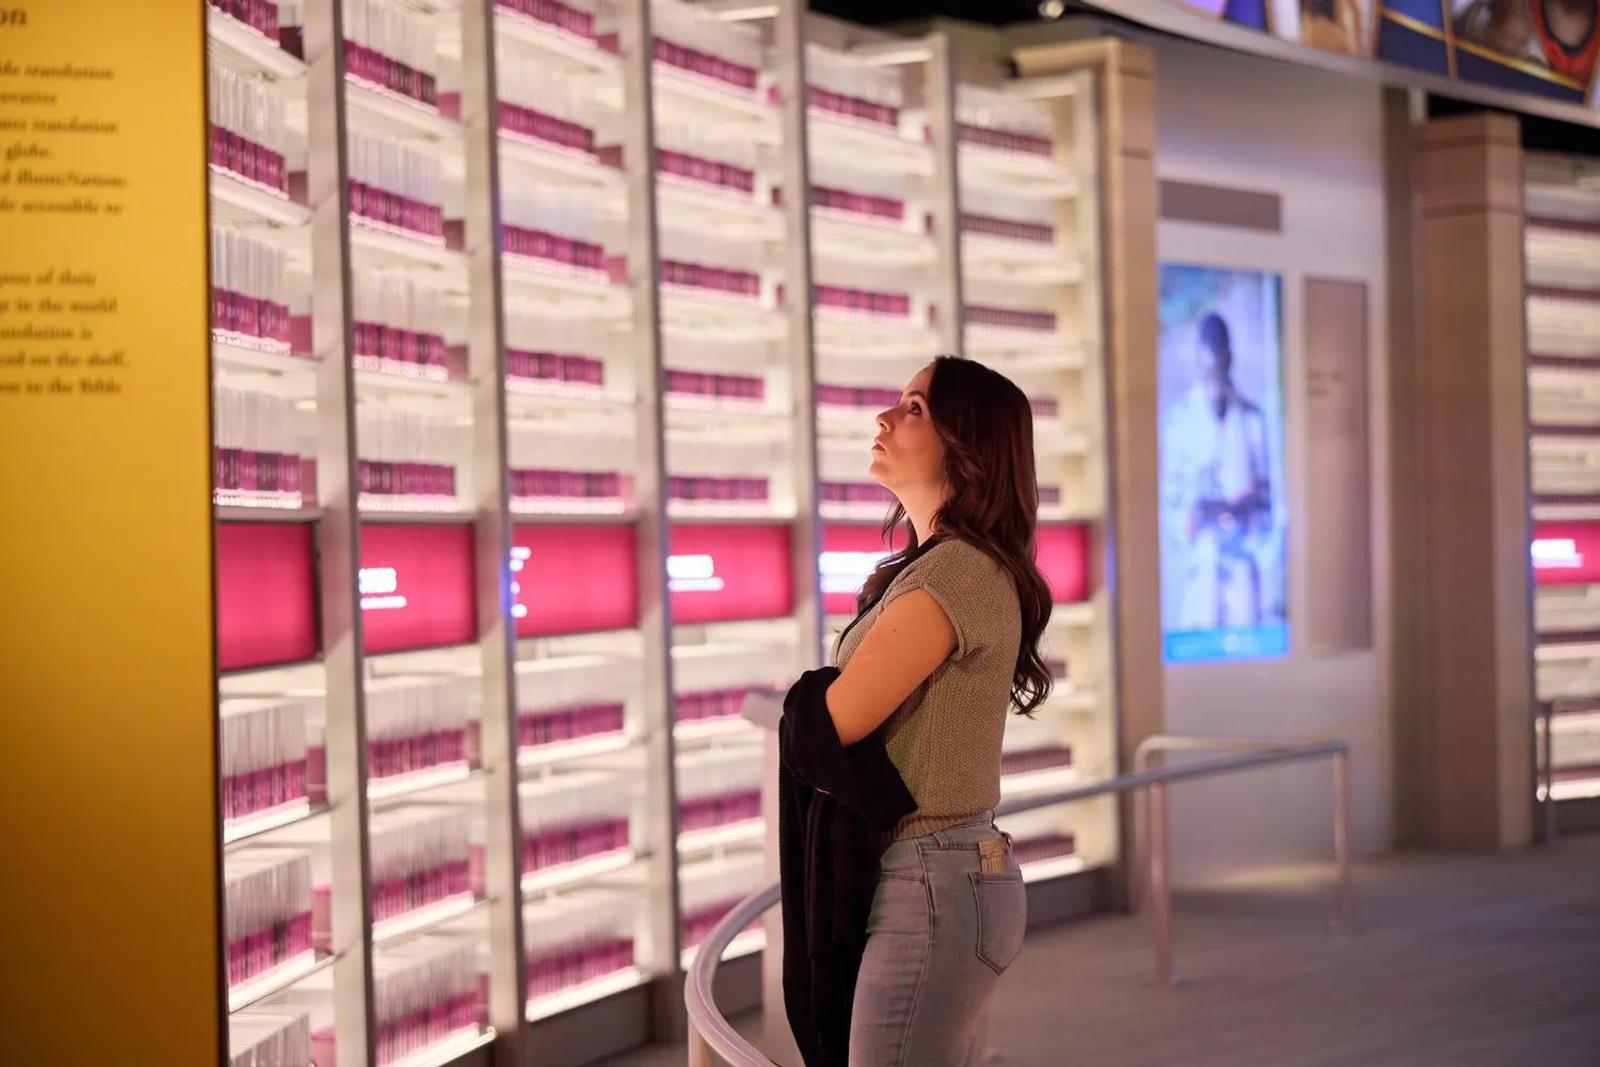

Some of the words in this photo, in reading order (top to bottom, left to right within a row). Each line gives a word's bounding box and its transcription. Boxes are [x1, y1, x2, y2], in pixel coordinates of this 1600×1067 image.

[39, 297, 63, 313] the
[56, 350, 79, 366] the
[48, 376, 73, 394] the
